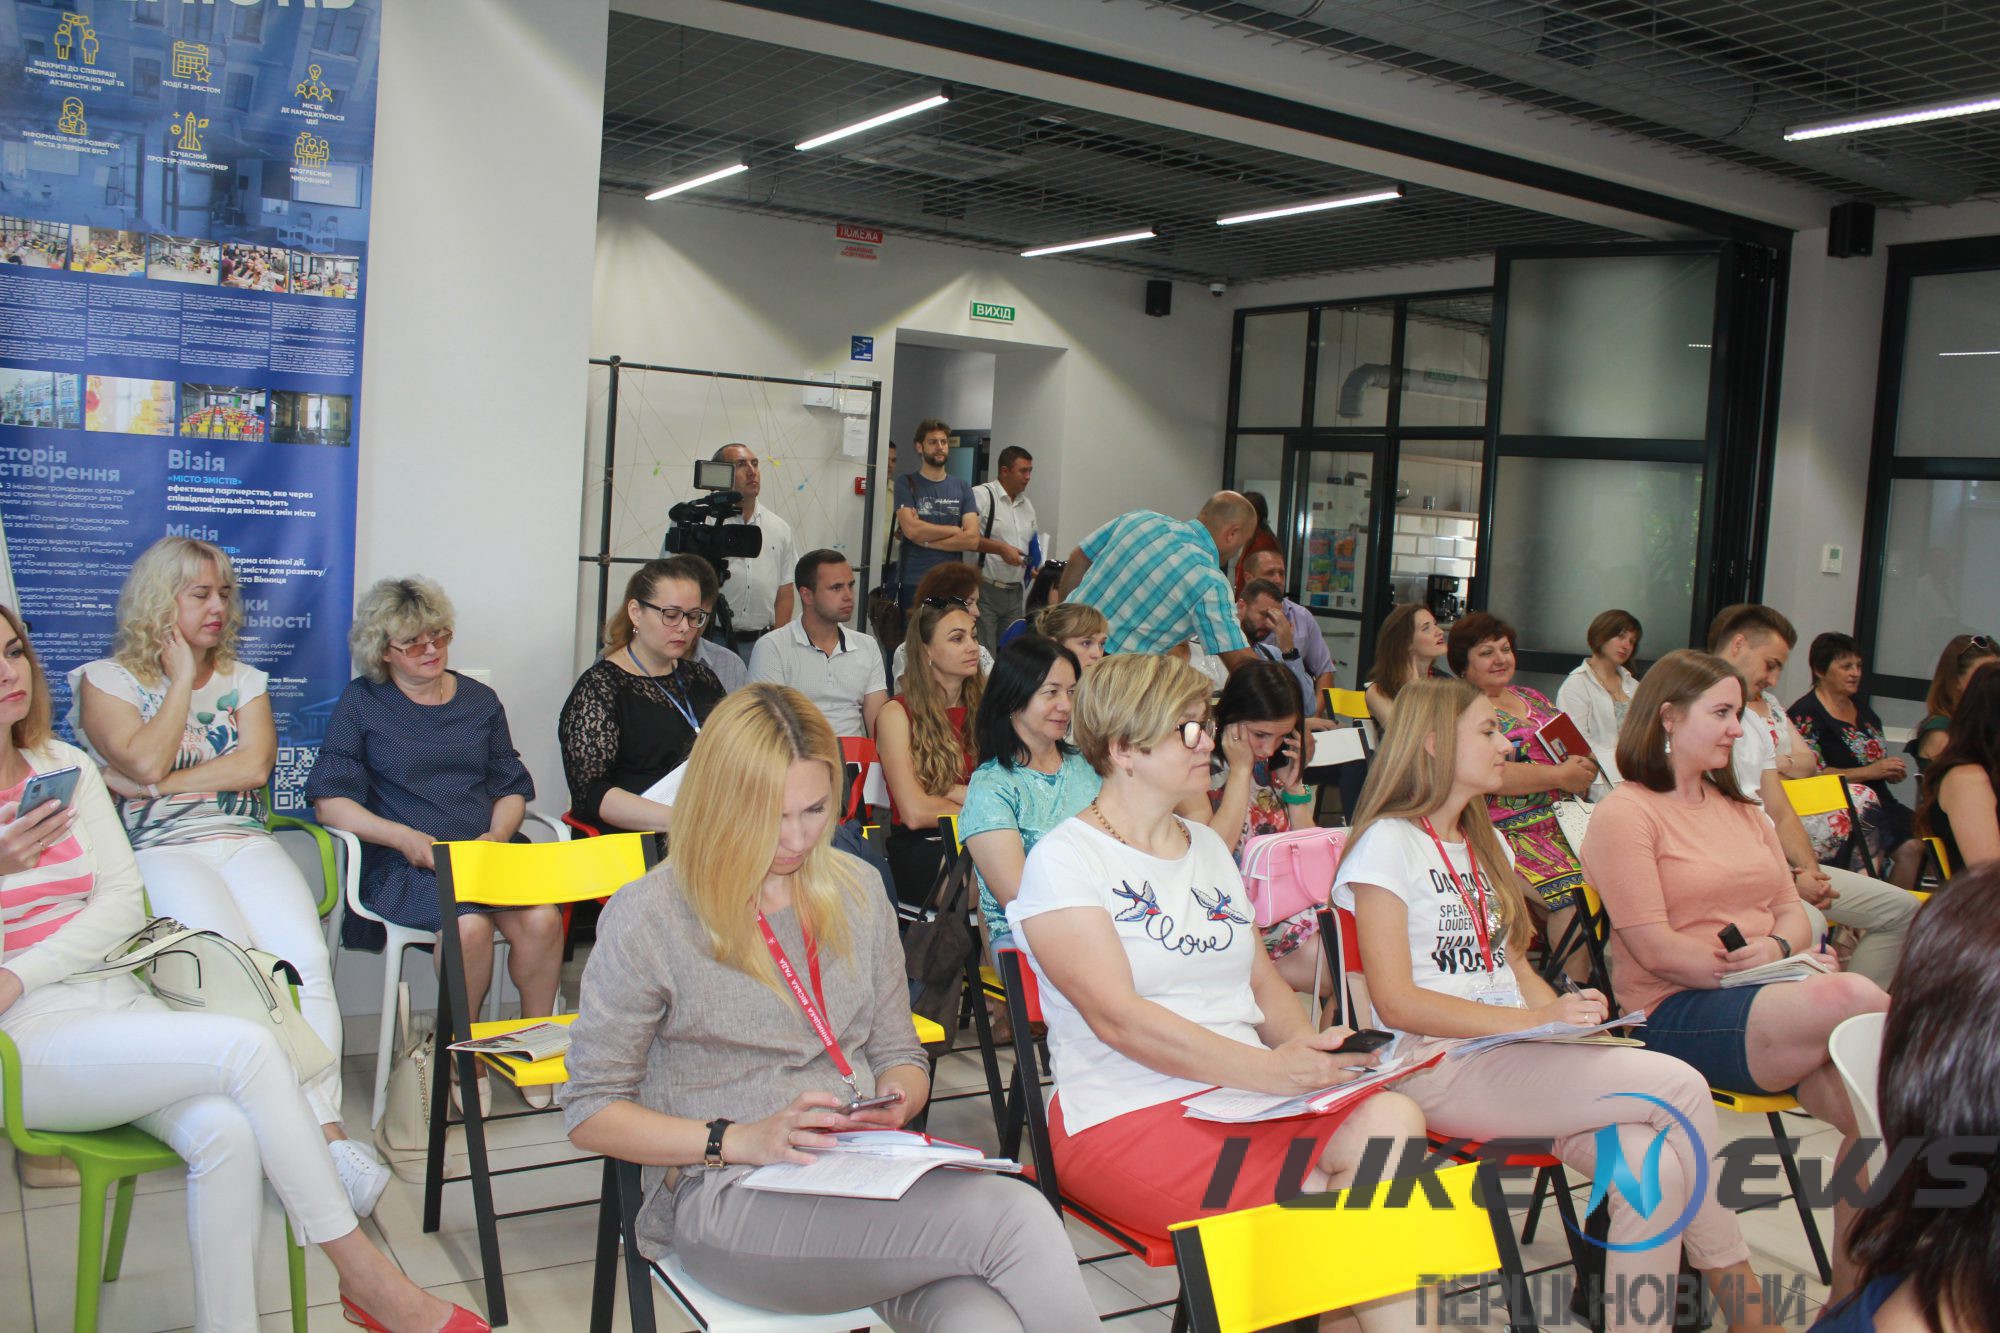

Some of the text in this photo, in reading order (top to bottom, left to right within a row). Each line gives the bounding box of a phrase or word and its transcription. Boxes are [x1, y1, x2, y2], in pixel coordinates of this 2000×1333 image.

[840, 226, 879, 241] ПОЖЕЖА
[976, 304, 1011, 320] ВИХІД
[168, 449, 225, 472] Візія
[0, 463, 120, 483] створення
[167, 475, 242, 485] «МІСТО ЗМІСТІВ»
[167, 485, 214, 495] ефективне
[215, 487, 271, 498] партнерство,
[288, 491, 314, 499] через
[167, 494, 289, 507] співвідповідальність творить
[167, 504, 226, 514] спільнозмісти
[226, 507, 242, 515] для
[243, 507, 274, 516] якісних
[294, 509, 317, 518] міста
[166, 523, 219, 542] Місія
[258, 557, 292, 566] спільної
[293, 558, 307, 567] дії,
[253, 575, 287, 584] Вінниця
[1438, 917, 1474, 932] LOUDER
[1146, 913, 1233, 956] love
[1436, 935, 1475, 951] THAN
[779, 957, 833, 1047] ВІННИЦЬКА МІСЬКА РАДА
